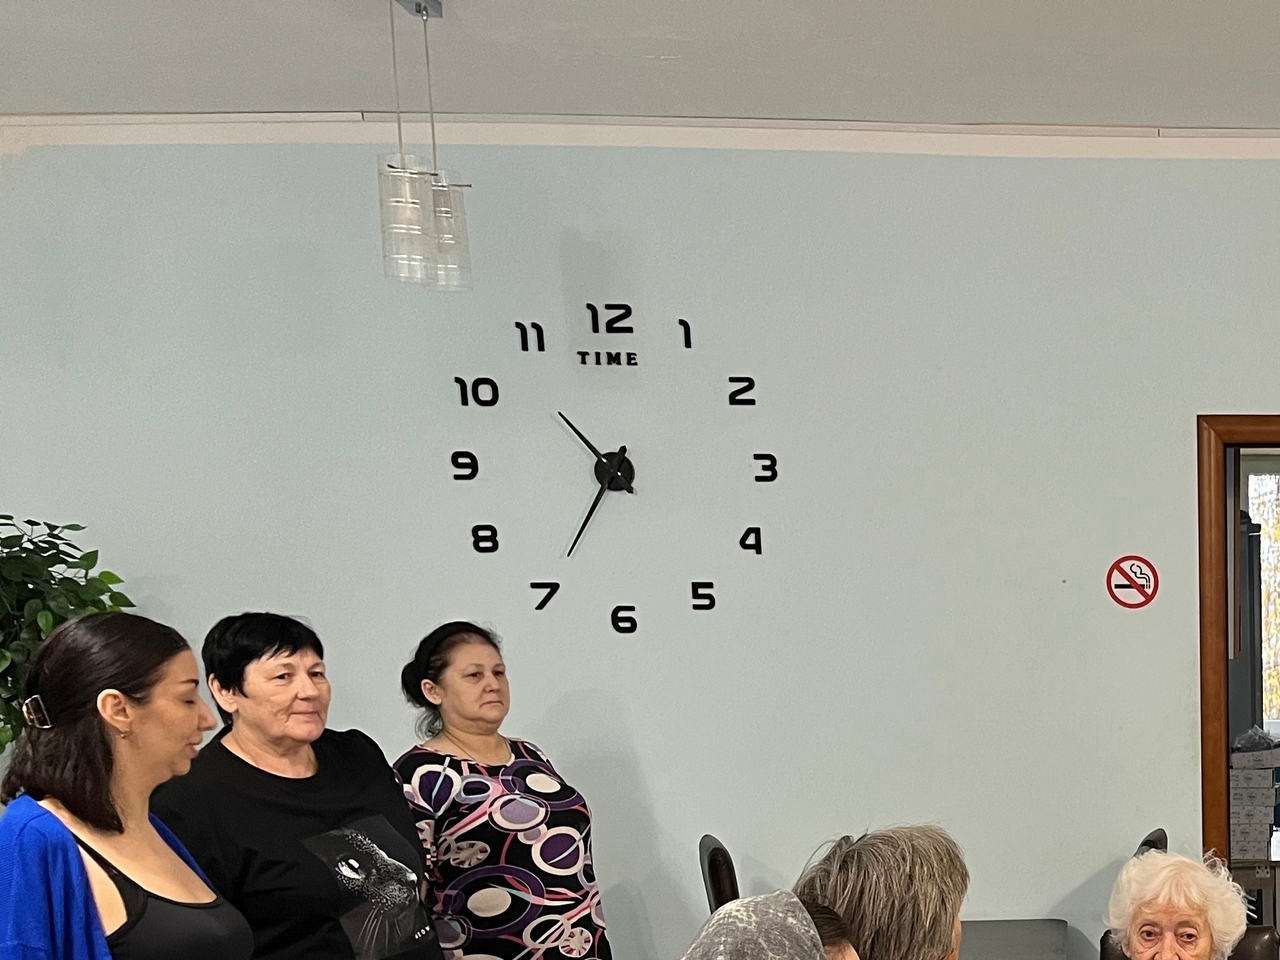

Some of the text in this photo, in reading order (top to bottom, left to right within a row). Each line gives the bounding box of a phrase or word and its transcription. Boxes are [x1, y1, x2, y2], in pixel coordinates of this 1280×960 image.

[585, 302, 634, 334] 12
[514, 321, 546, 352] 11
[678, 318, 692, 349] 1
[576, 350, 639, 367] TIME
[453, 376, 500, 407] 10
[728, 376, 757, 406] 2
[450, 450, 479, 481] 9
[752, 453, 778, 483] 3
[471, 524, 500, 554] 8
[738, 526, 763, 555] 4
[529, 582, 561, 611] 7
[691, 581, 716, 611] 5
[610, 605, 638, 634] 6
